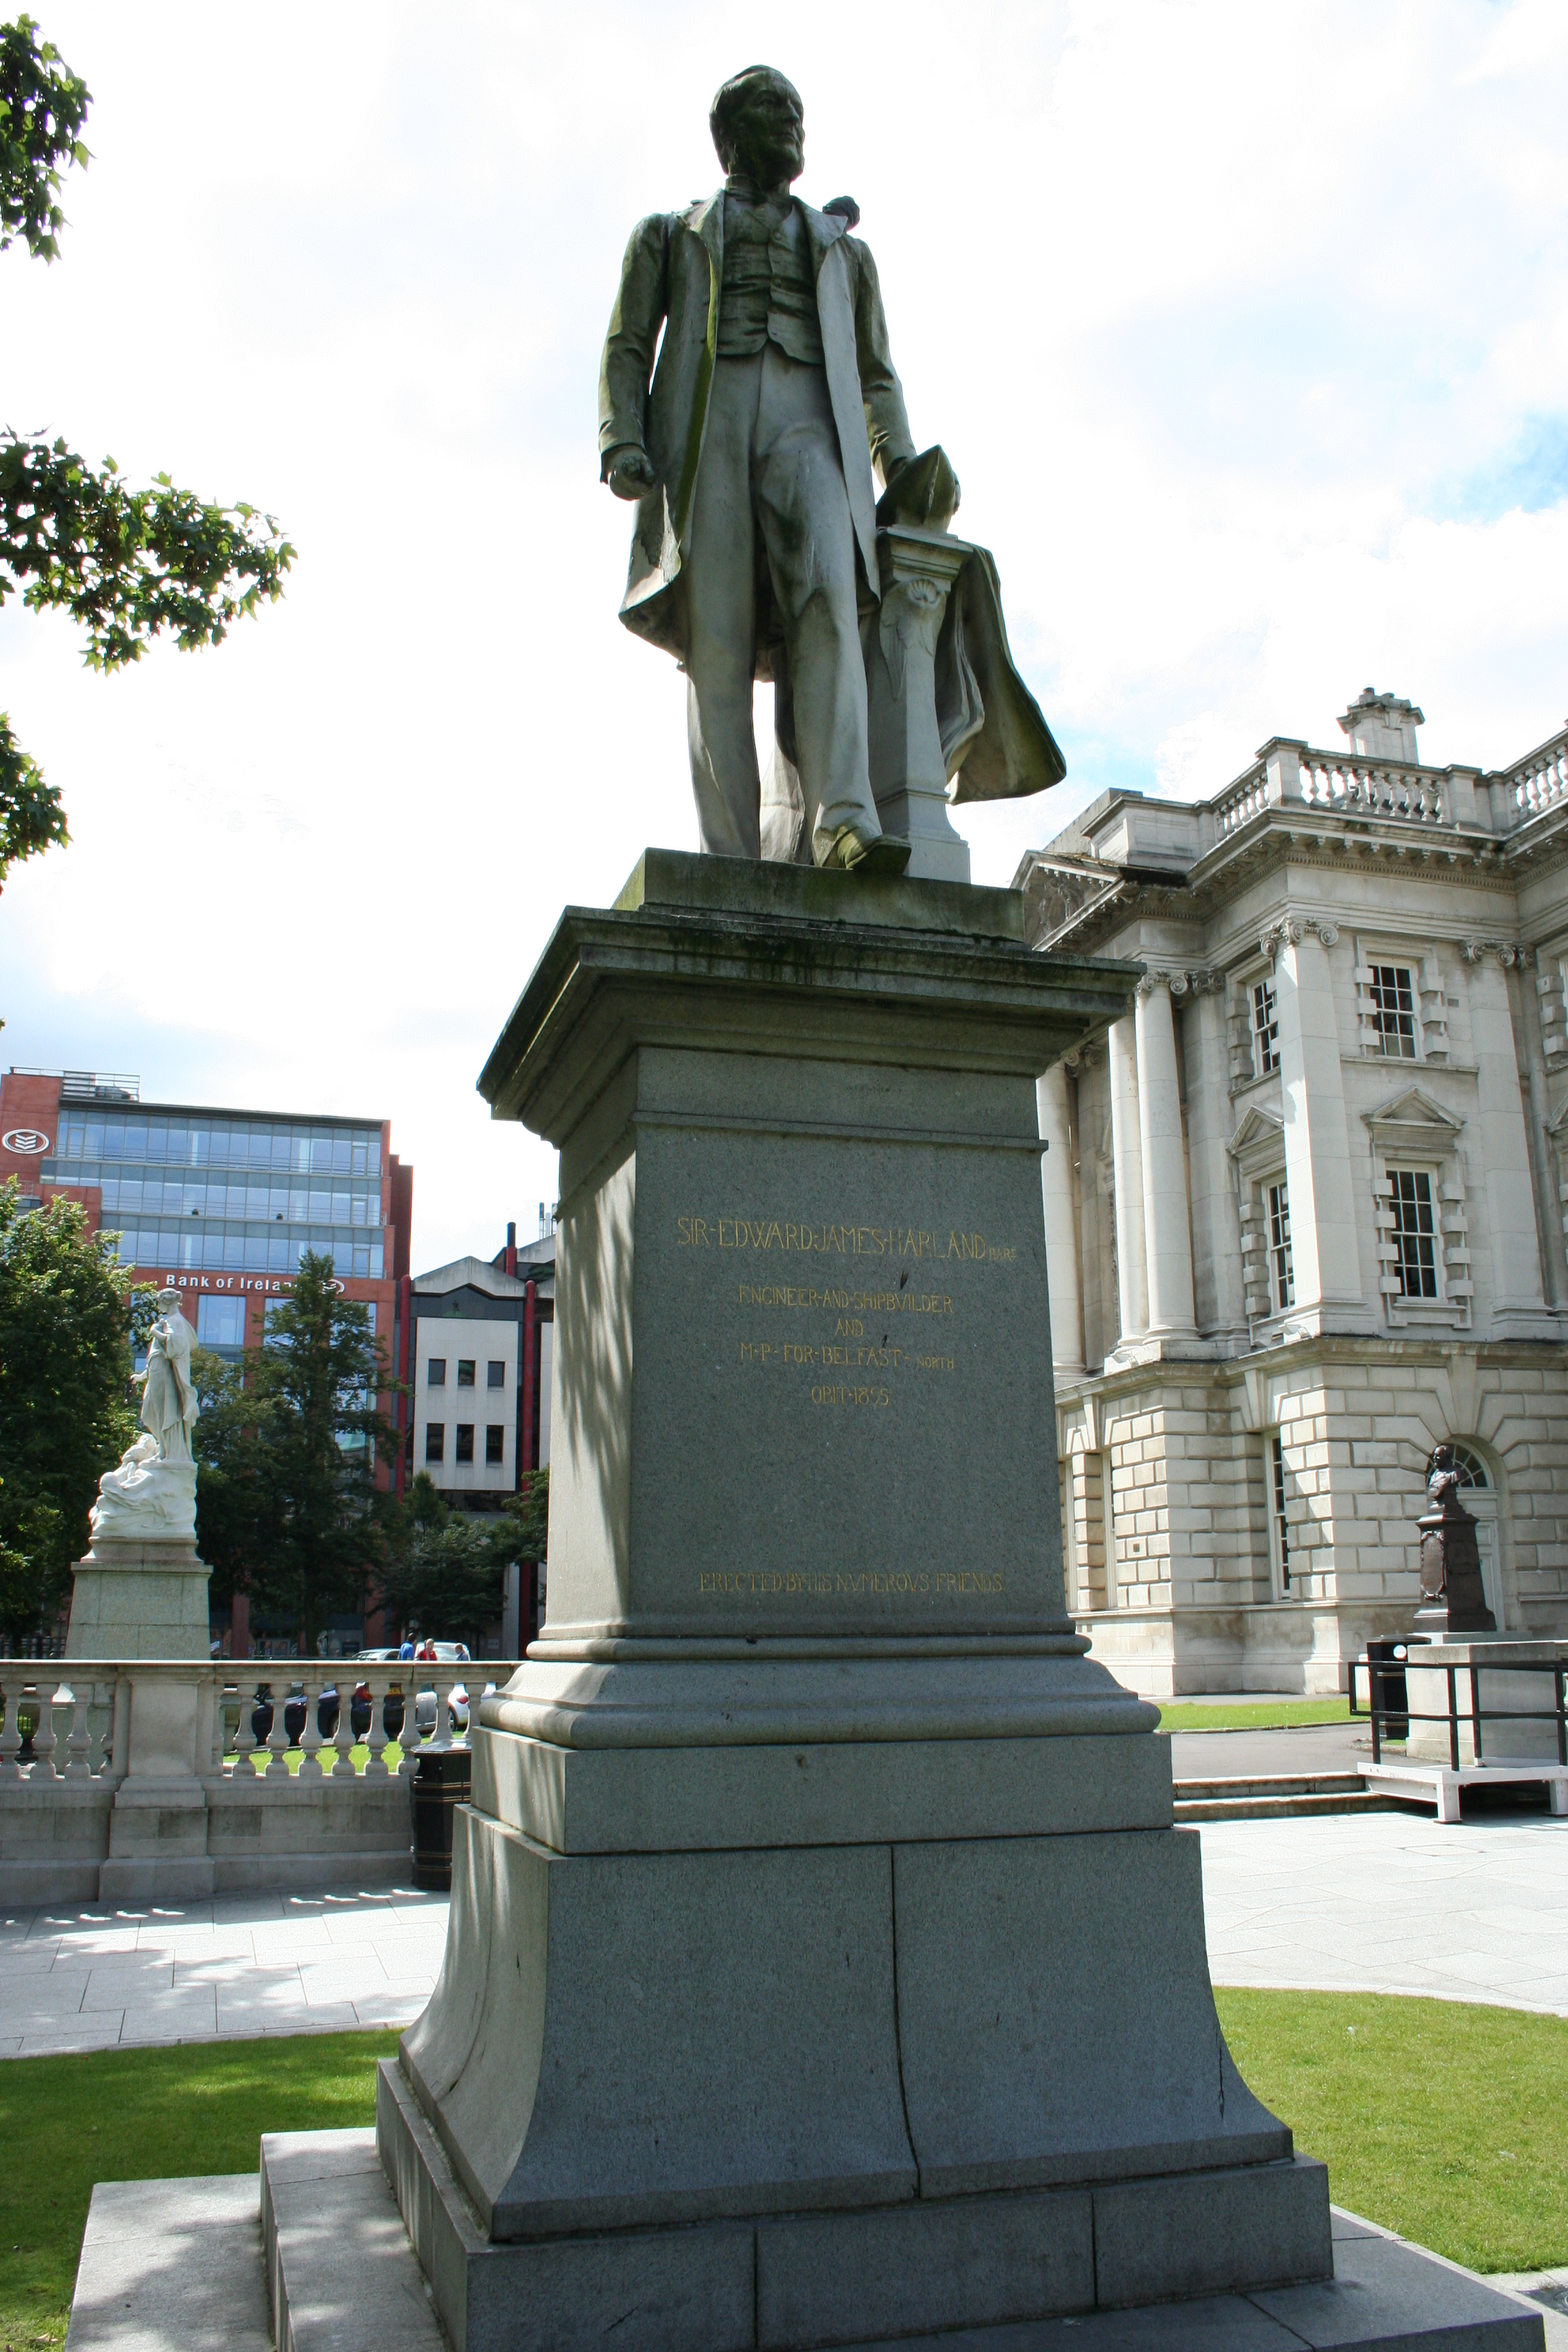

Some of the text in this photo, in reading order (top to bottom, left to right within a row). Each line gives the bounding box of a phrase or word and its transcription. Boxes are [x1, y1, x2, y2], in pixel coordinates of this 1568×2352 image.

[678, 1217, 710, 1246] SIR
[719, 1219, 813, 1250] EDWARD
[814, 1225, 885, 1255] JAMES
[888, 1227, 986, 1260] HARLAND
[166, 1274, 210, 1288] Bank
[216, 1277, 235, 1290] of
[834, 1318, 864, 1337] AND
[783, 1344, 814, 1364] FOR
[822, 1345, 902, 1367] BELFAST
[917, 1356, 954, 1370] NORTH
[811, 1386, 846, 1405] OBIT
[700, 1572, 783, 1592] ERECTED
[936, 1571, 1003, 1592] FRIENDS
